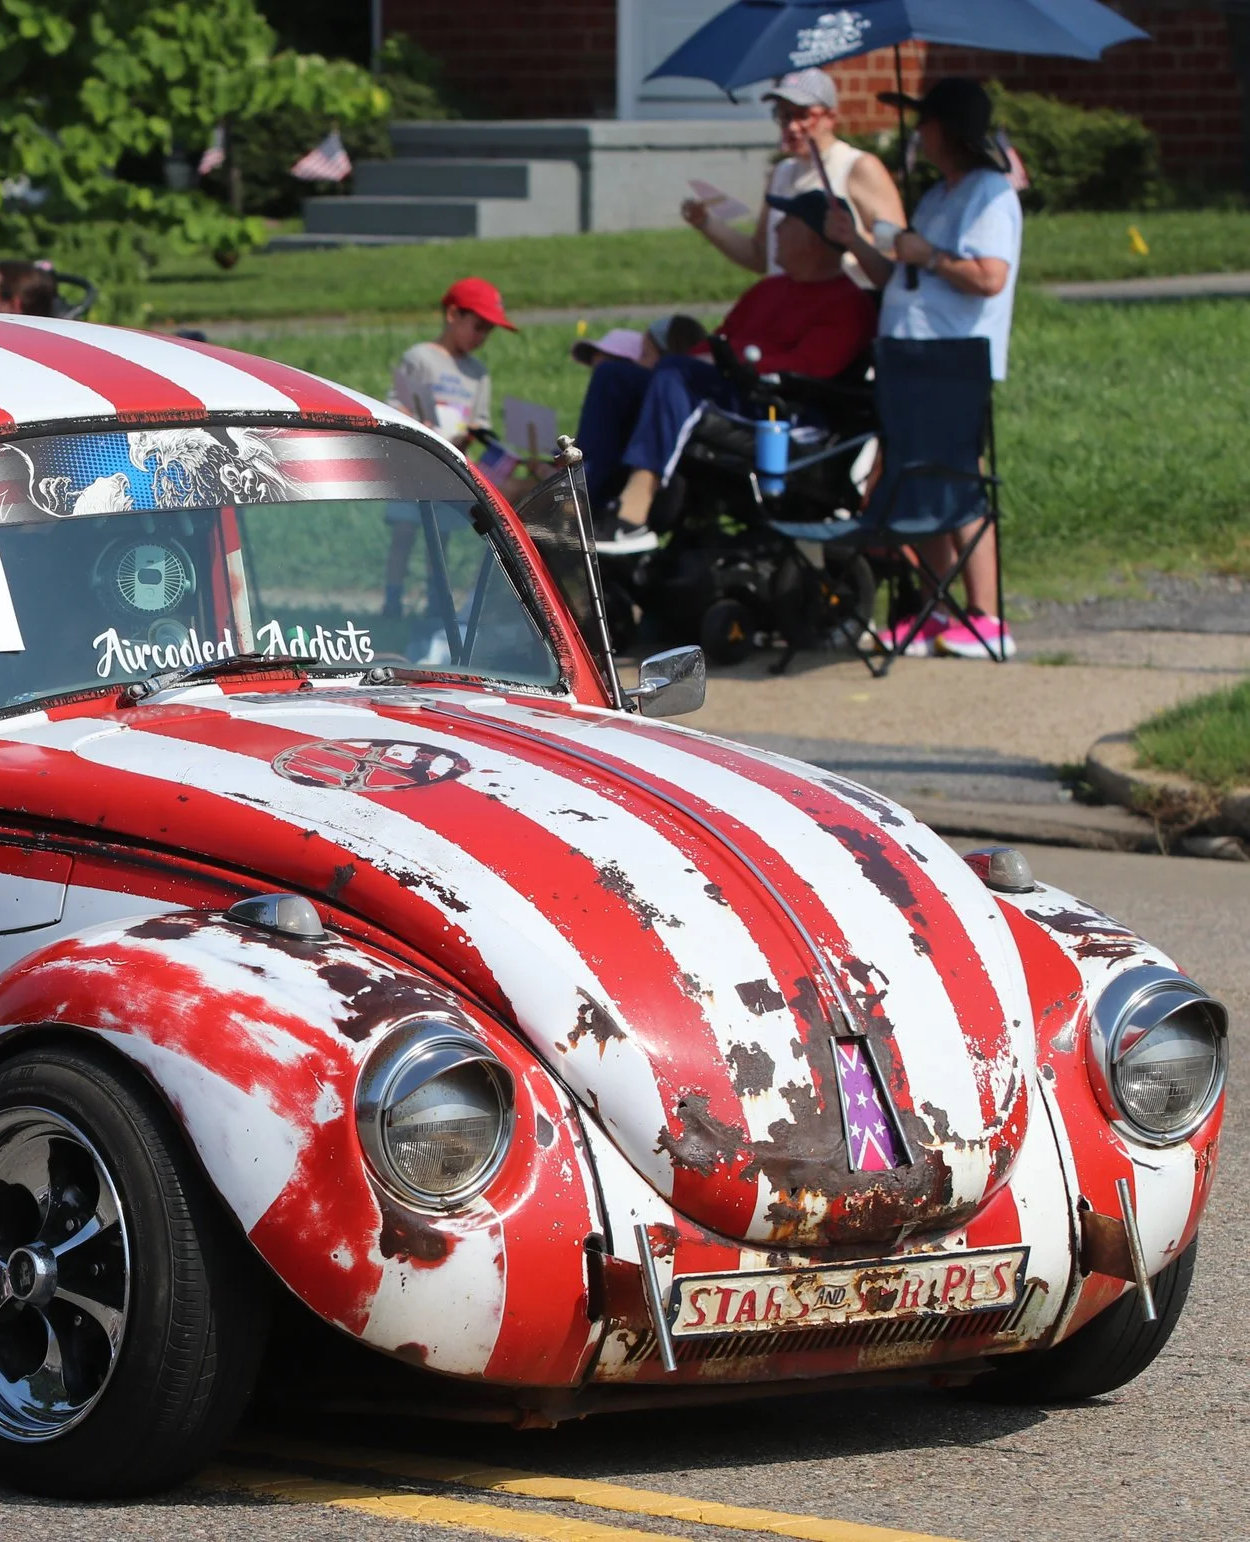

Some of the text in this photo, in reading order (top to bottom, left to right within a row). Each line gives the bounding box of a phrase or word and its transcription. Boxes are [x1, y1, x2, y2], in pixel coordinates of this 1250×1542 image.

[92, 620, 375, 678] Aircooled Addicts
[682, 1275, 817, 1327] STARS
[813, 1286, 846, 1306] AND
